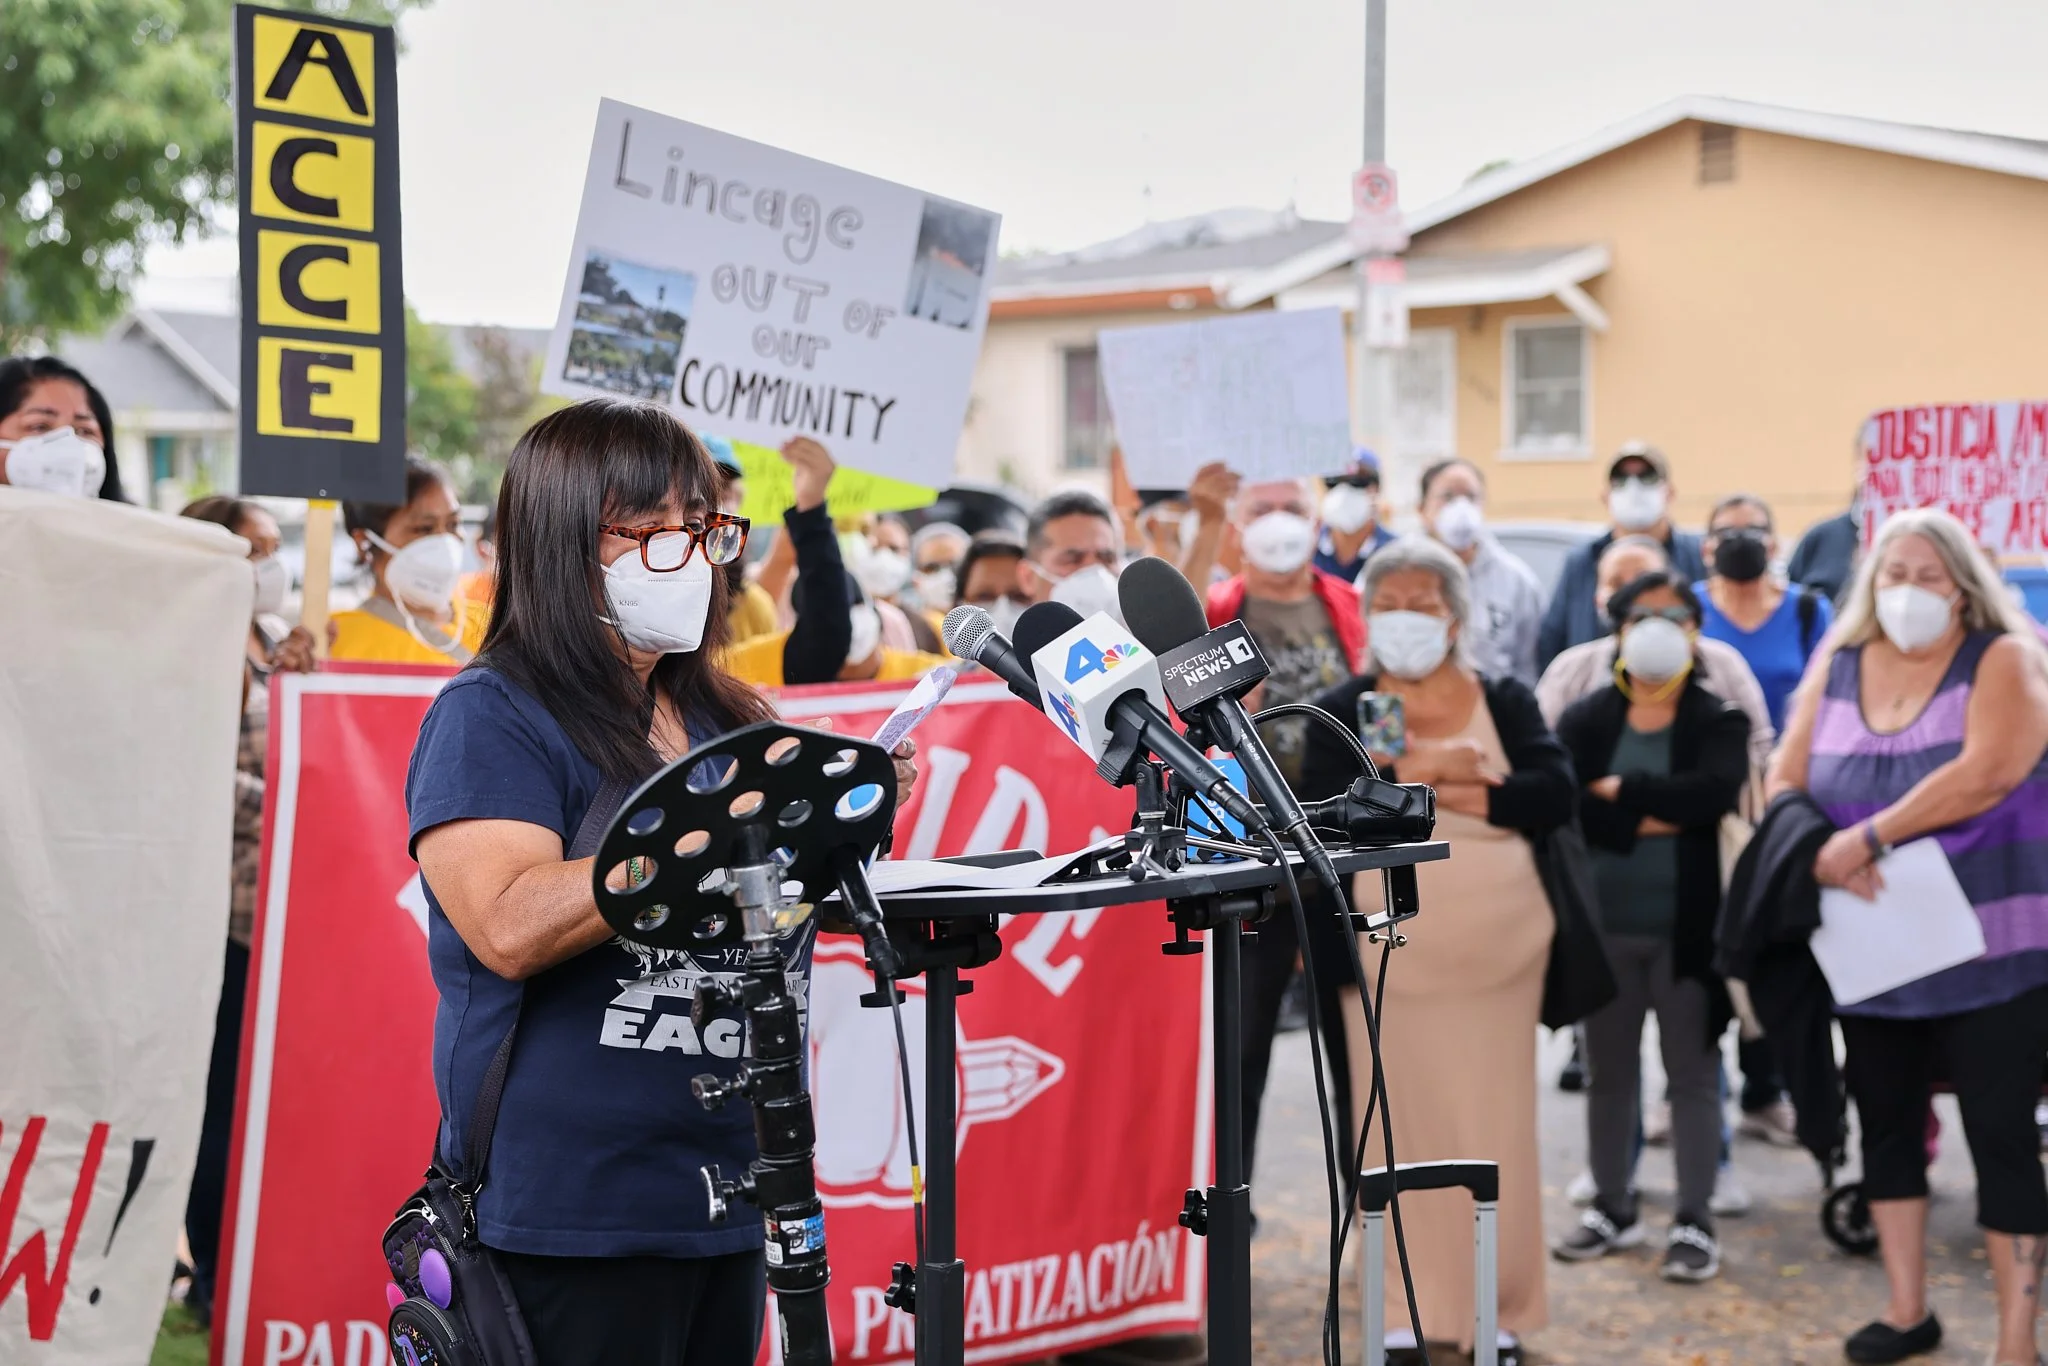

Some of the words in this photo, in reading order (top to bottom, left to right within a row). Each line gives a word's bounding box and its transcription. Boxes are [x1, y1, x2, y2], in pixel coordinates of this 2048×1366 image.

[265, 28, 369, 435] ACCE
[680, 358, 897, 444] COMMUNITY
[1064, 637, 1109, 685] 4
[1164, 645, 1225, 681] SPECTRUM
[1237, 642, 1250, 657] 1
[1183, 656, 1232, 687] NEWS
[0, 1115, 156, 1342] W!
